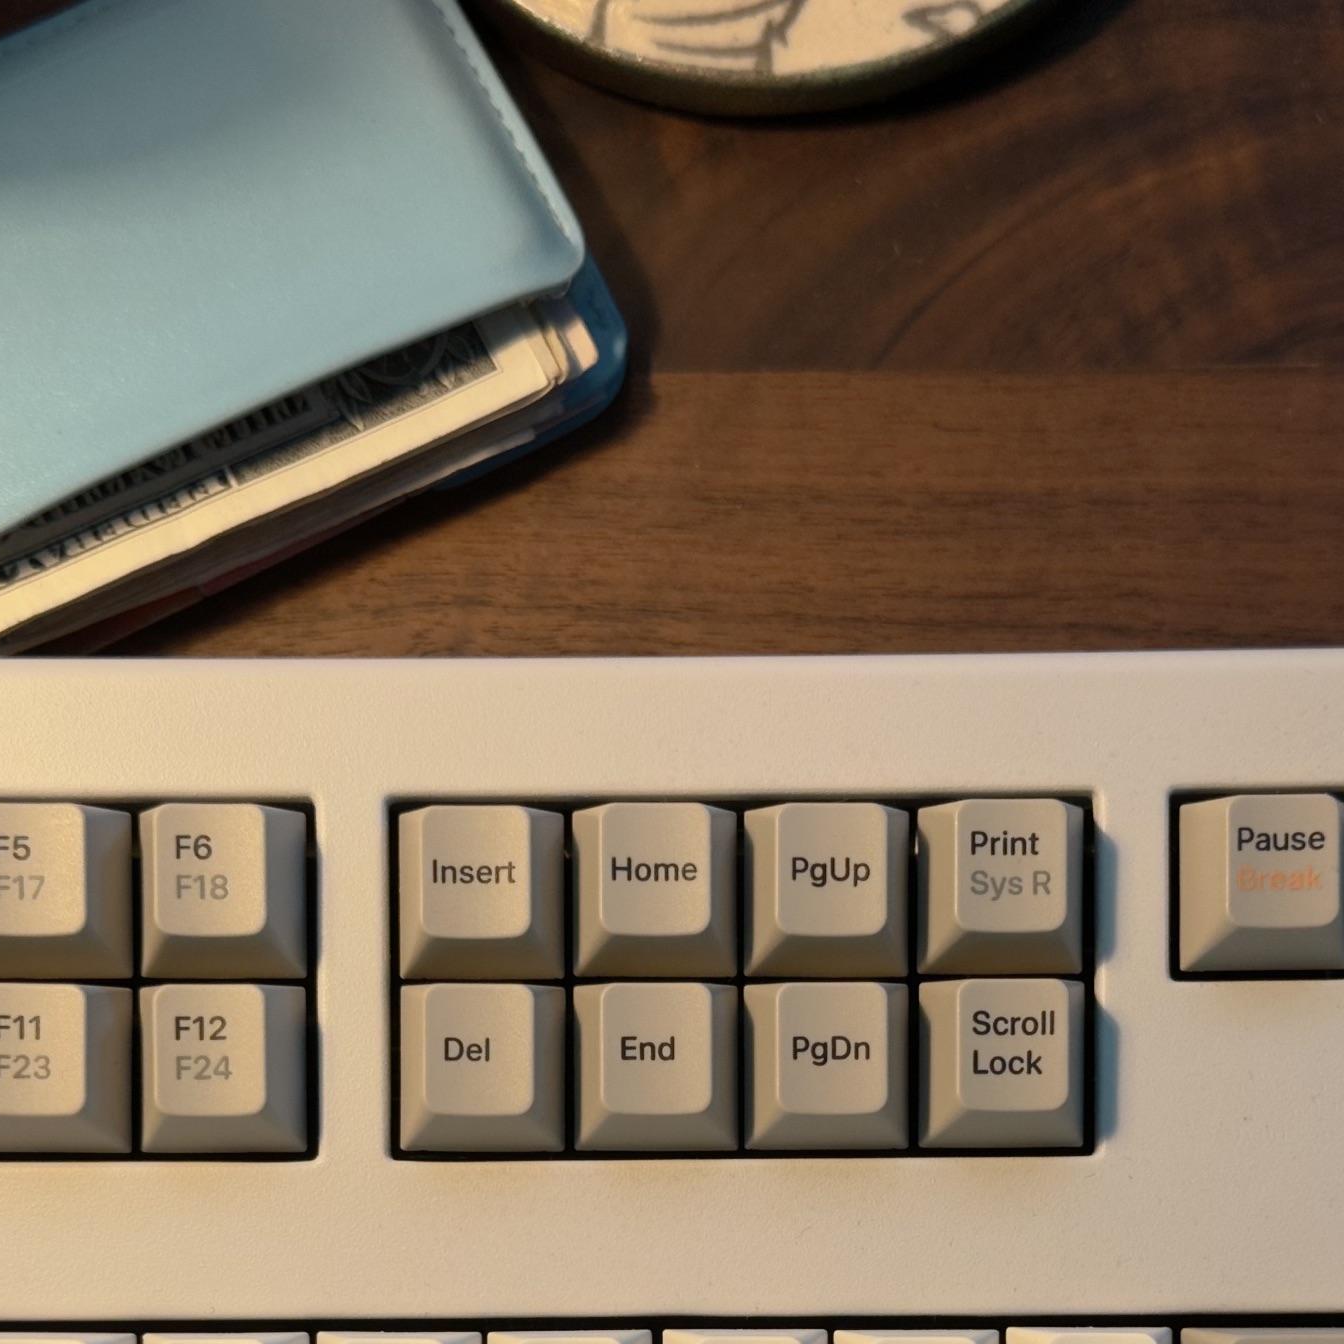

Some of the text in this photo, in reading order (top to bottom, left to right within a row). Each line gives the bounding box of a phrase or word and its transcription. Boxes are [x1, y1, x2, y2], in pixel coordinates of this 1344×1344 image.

[175, 834, 212, 860] F6
[971, 830, 1039, 856] Print
[1238, 827, 1325, 851] Pause
[432, 859, 515, 884] Insert
[611, 857, 697, 882] Home
[792, 857, 870, 888] PgUp
[1236, 865, 1322, 892] Break
[176, 874, 229, 900] F18
[970, 870, 1051, 901] Sys R
[175, 1016, 227, 1041] F12
[972, 1010, 1055, 1036] Scroll
[444, 1037, 490, 1062] Del
[621, 1036, 675, 1061] End
[793, 1036, 870, 1066] PgDn
[176, 1055, 232, 1081] F24
[973, 1050, 1042, 1075] Lock
